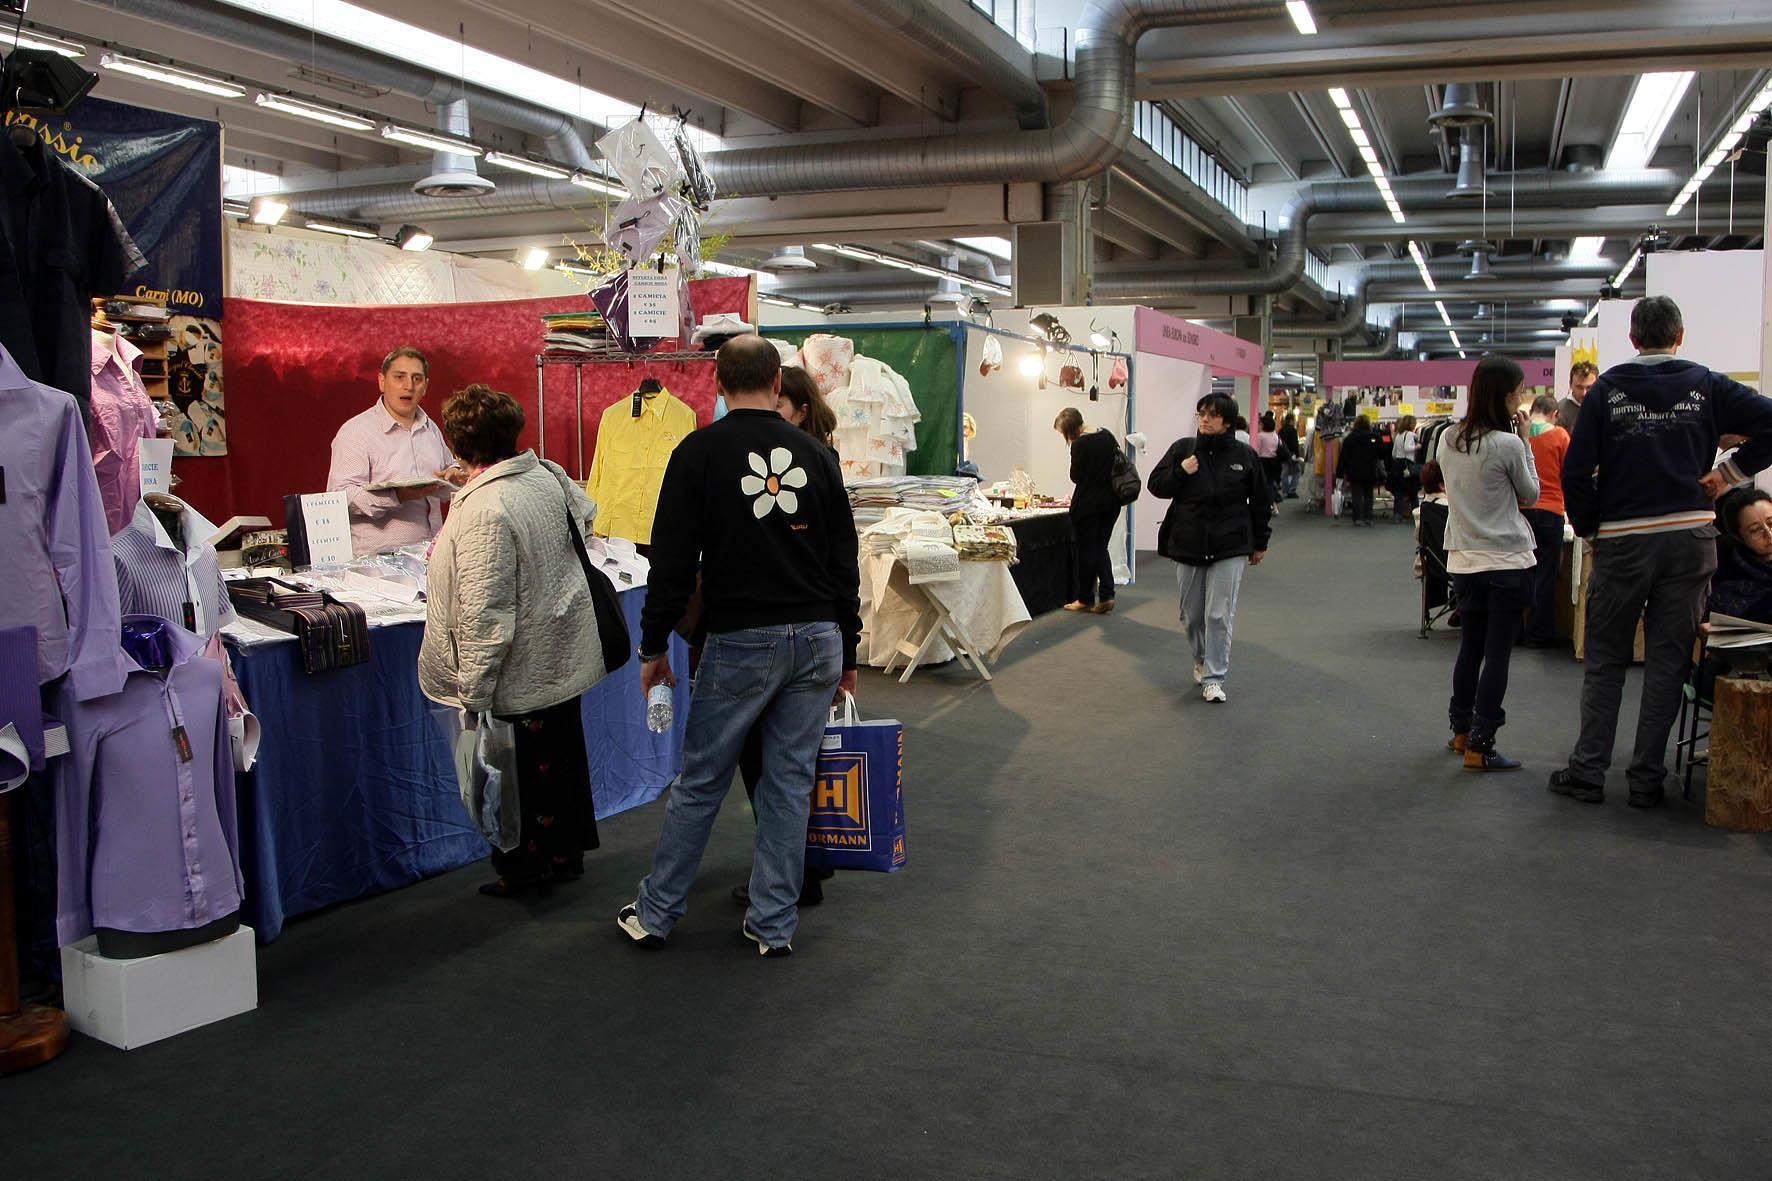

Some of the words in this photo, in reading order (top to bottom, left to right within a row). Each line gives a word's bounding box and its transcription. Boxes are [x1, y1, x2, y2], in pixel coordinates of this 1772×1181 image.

[171, 289, 204, 308] (MO)
[1613, 404, 1646, 416] BRITISH
[1637, 410, 1677, 421] ALBERTA
[817, 779, 844, 808] H
